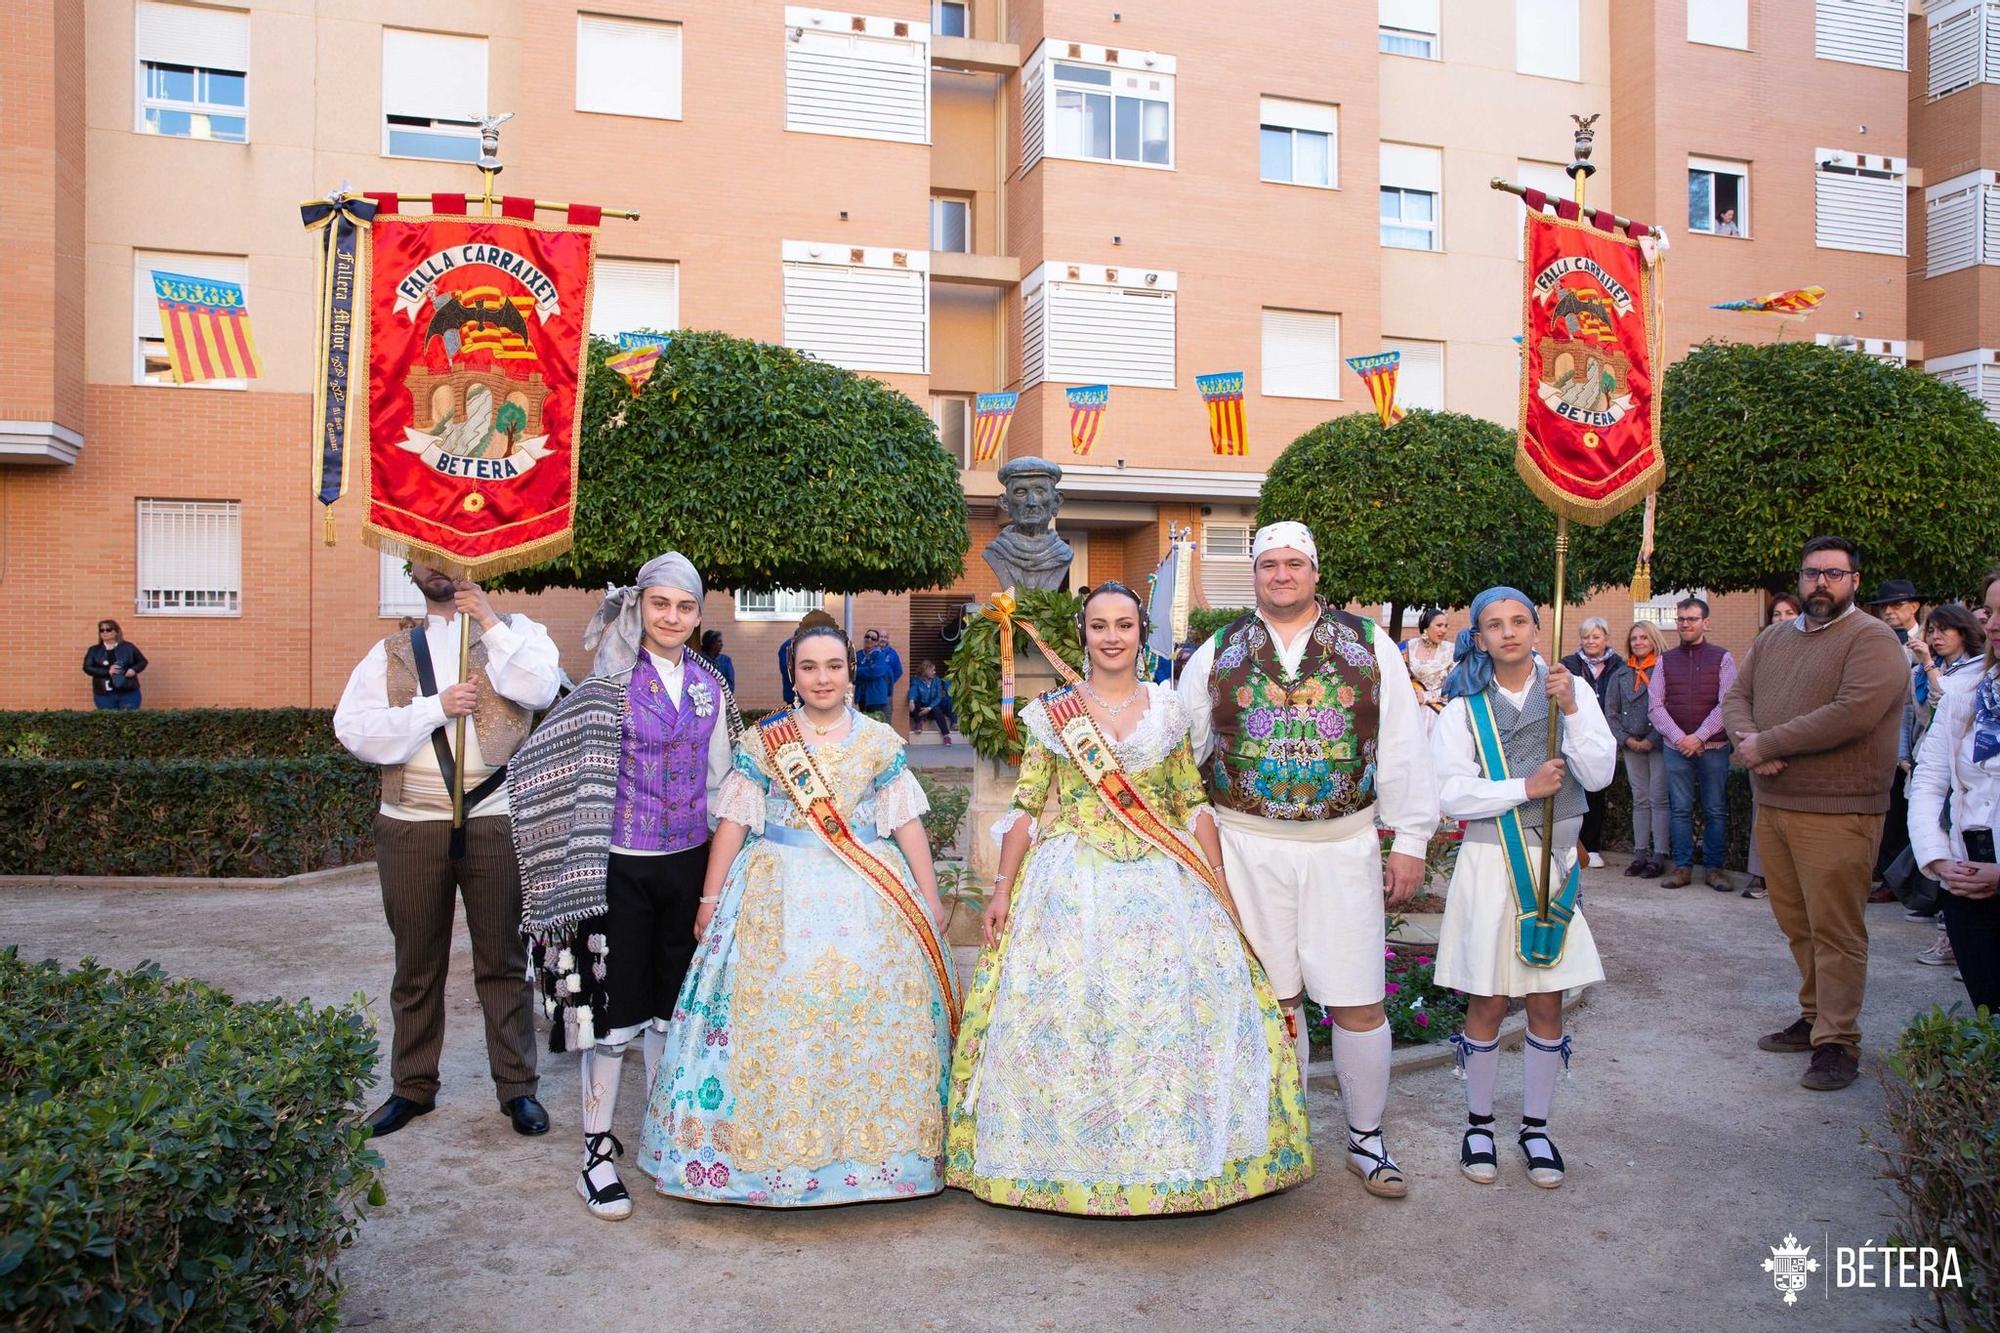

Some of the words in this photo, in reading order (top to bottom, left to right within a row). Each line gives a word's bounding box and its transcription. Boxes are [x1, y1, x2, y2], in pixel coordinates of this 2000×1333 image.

[335, 248, 355, 300] Fallera
[400, 252, 454, 299] FALLA
[463, 245, 556, 304] CARRAIXET
[1537, 259, 1569, 290] FALLA
[1574, 257, 1630, 303] CARRAIXET
[331, 308, 350, 351] Major
[330, 356, 346, 378] 2020
[329, 379, 345, 403] 2022
[1556, 401, 1616, 426] BETERA
[436, 452, 518, 479] BETERA
